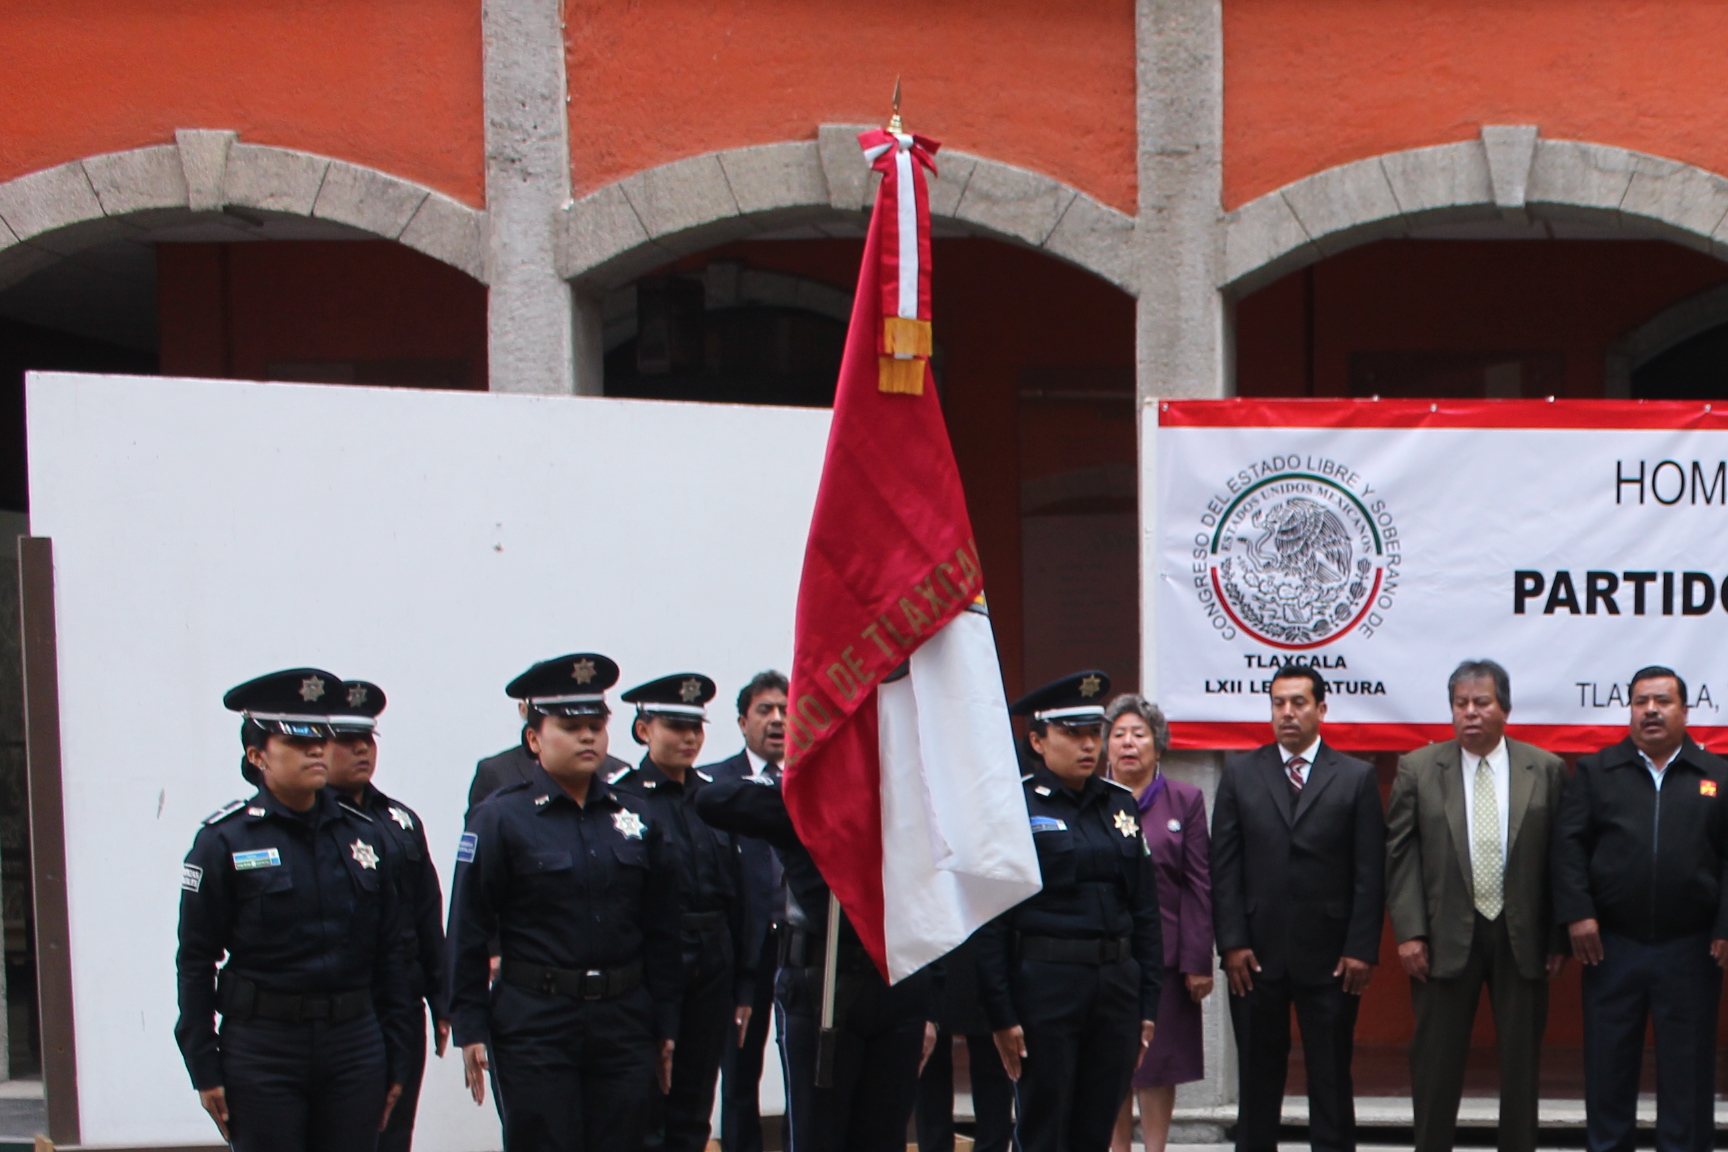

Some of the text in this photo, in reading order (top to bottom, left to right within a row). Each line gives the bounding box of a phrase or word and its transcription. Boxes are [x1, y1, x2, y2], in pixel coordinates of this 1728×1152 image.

[1220, 482, 1374, 554] ESTADOS UNIDOS MEXICANOS
[1193, 454, 1402, 641] CONGRESO DEL ESTADO LIBRE Y SOBERANO DE
[825, 644, 876, 701] DE
[1205, 680, 1386, 695] LXII LEATURA
[1244, 654, 1347, 669] TLAXCALA
